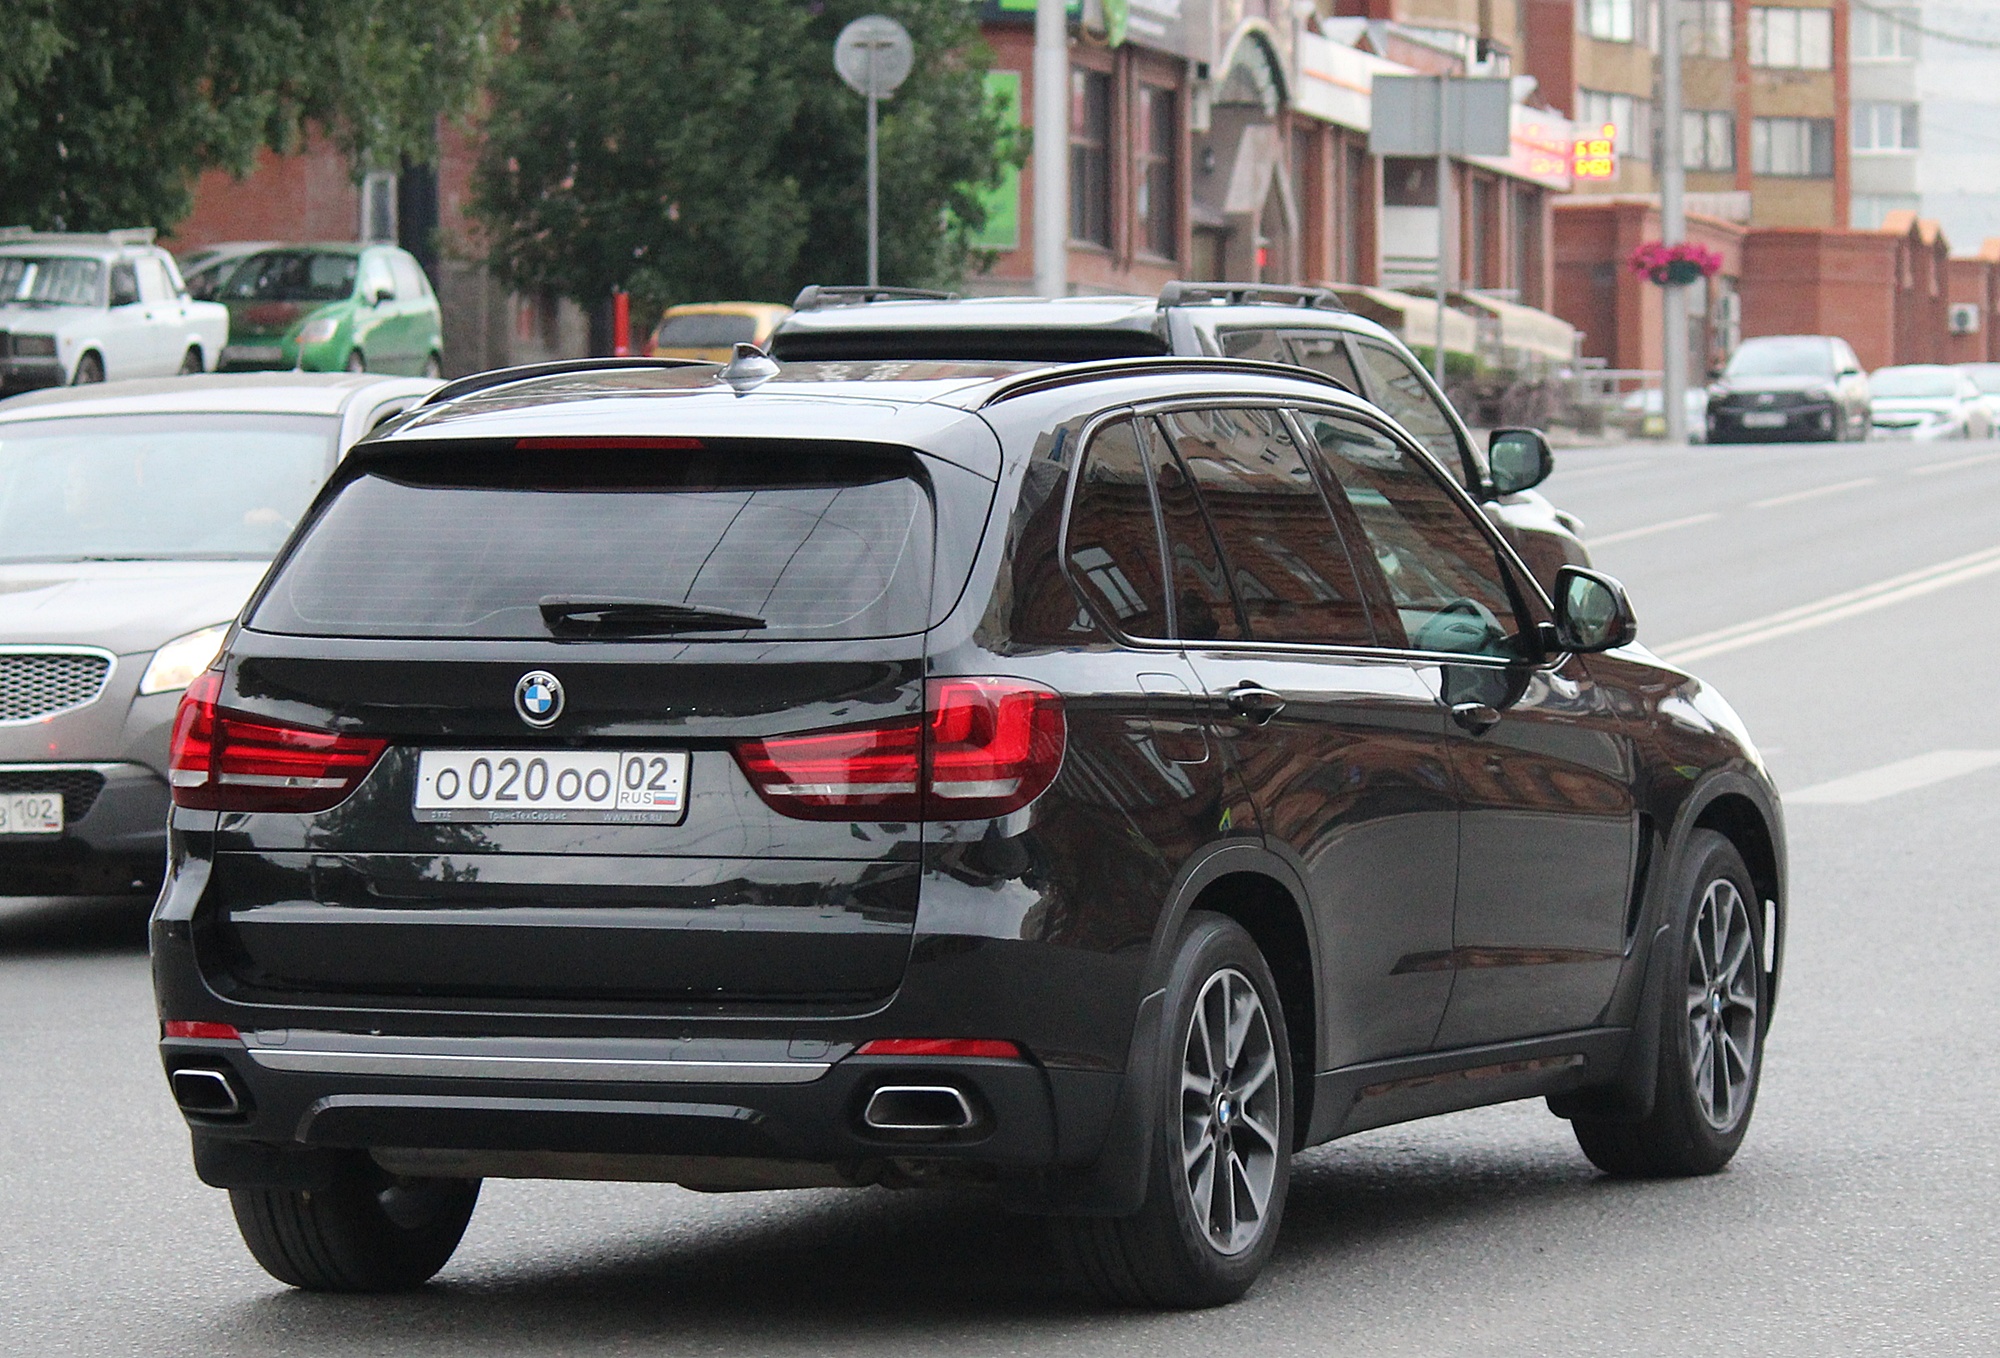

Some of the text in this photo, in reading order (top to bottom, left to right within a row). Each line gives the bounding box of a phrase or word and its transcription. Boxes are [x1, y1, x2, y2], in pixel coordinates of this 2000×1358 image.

[522, 676, 557, 691] BMW
[625, 757, 669, 790] 02
[620, 792, 652, 804] RUS
[14, 798, 53, 819] 102
